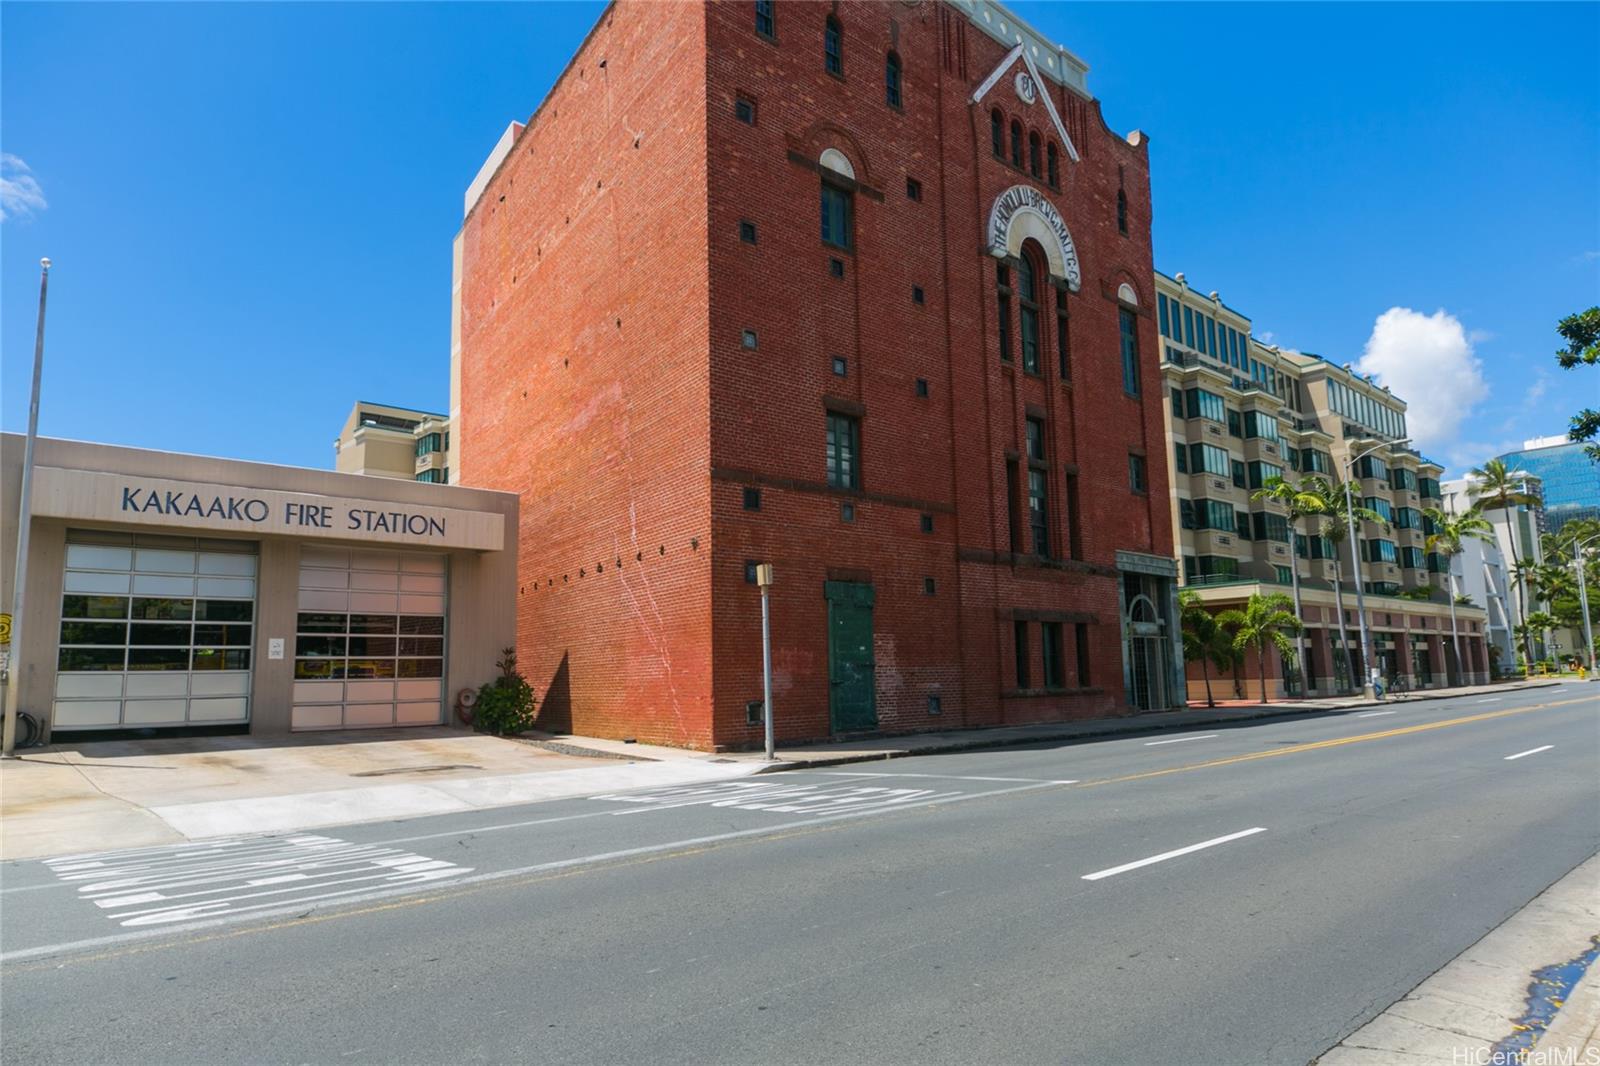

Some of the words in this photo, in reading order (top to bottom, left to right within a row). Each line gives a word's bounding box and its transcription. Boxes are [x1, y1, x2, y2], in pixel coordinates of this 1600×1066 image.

[122, 487, 269, 522] KAKAAKO
[285, 502, 333, 528] FIRE
[348, 509, 446, 537] STATION
